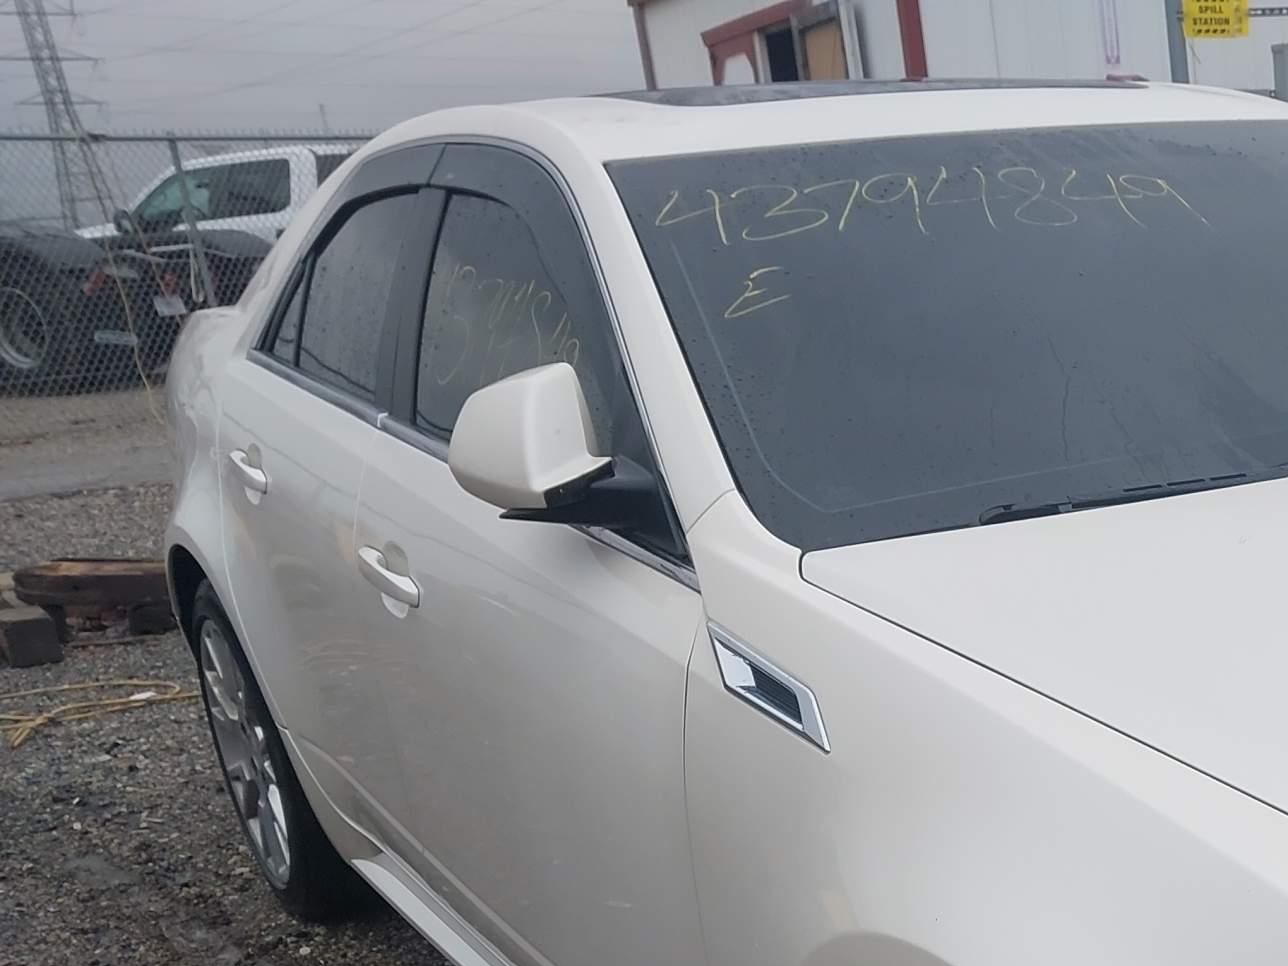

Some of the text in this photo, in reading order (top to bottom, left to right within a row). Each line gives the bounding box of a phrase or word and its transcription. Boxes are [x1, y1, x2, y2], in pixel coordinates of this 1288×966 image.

[1198, 5, 1223, 14] SPILL
[1192, 17, 1230, 25] STATION
[654, 165, 1211, 246] 43794849
